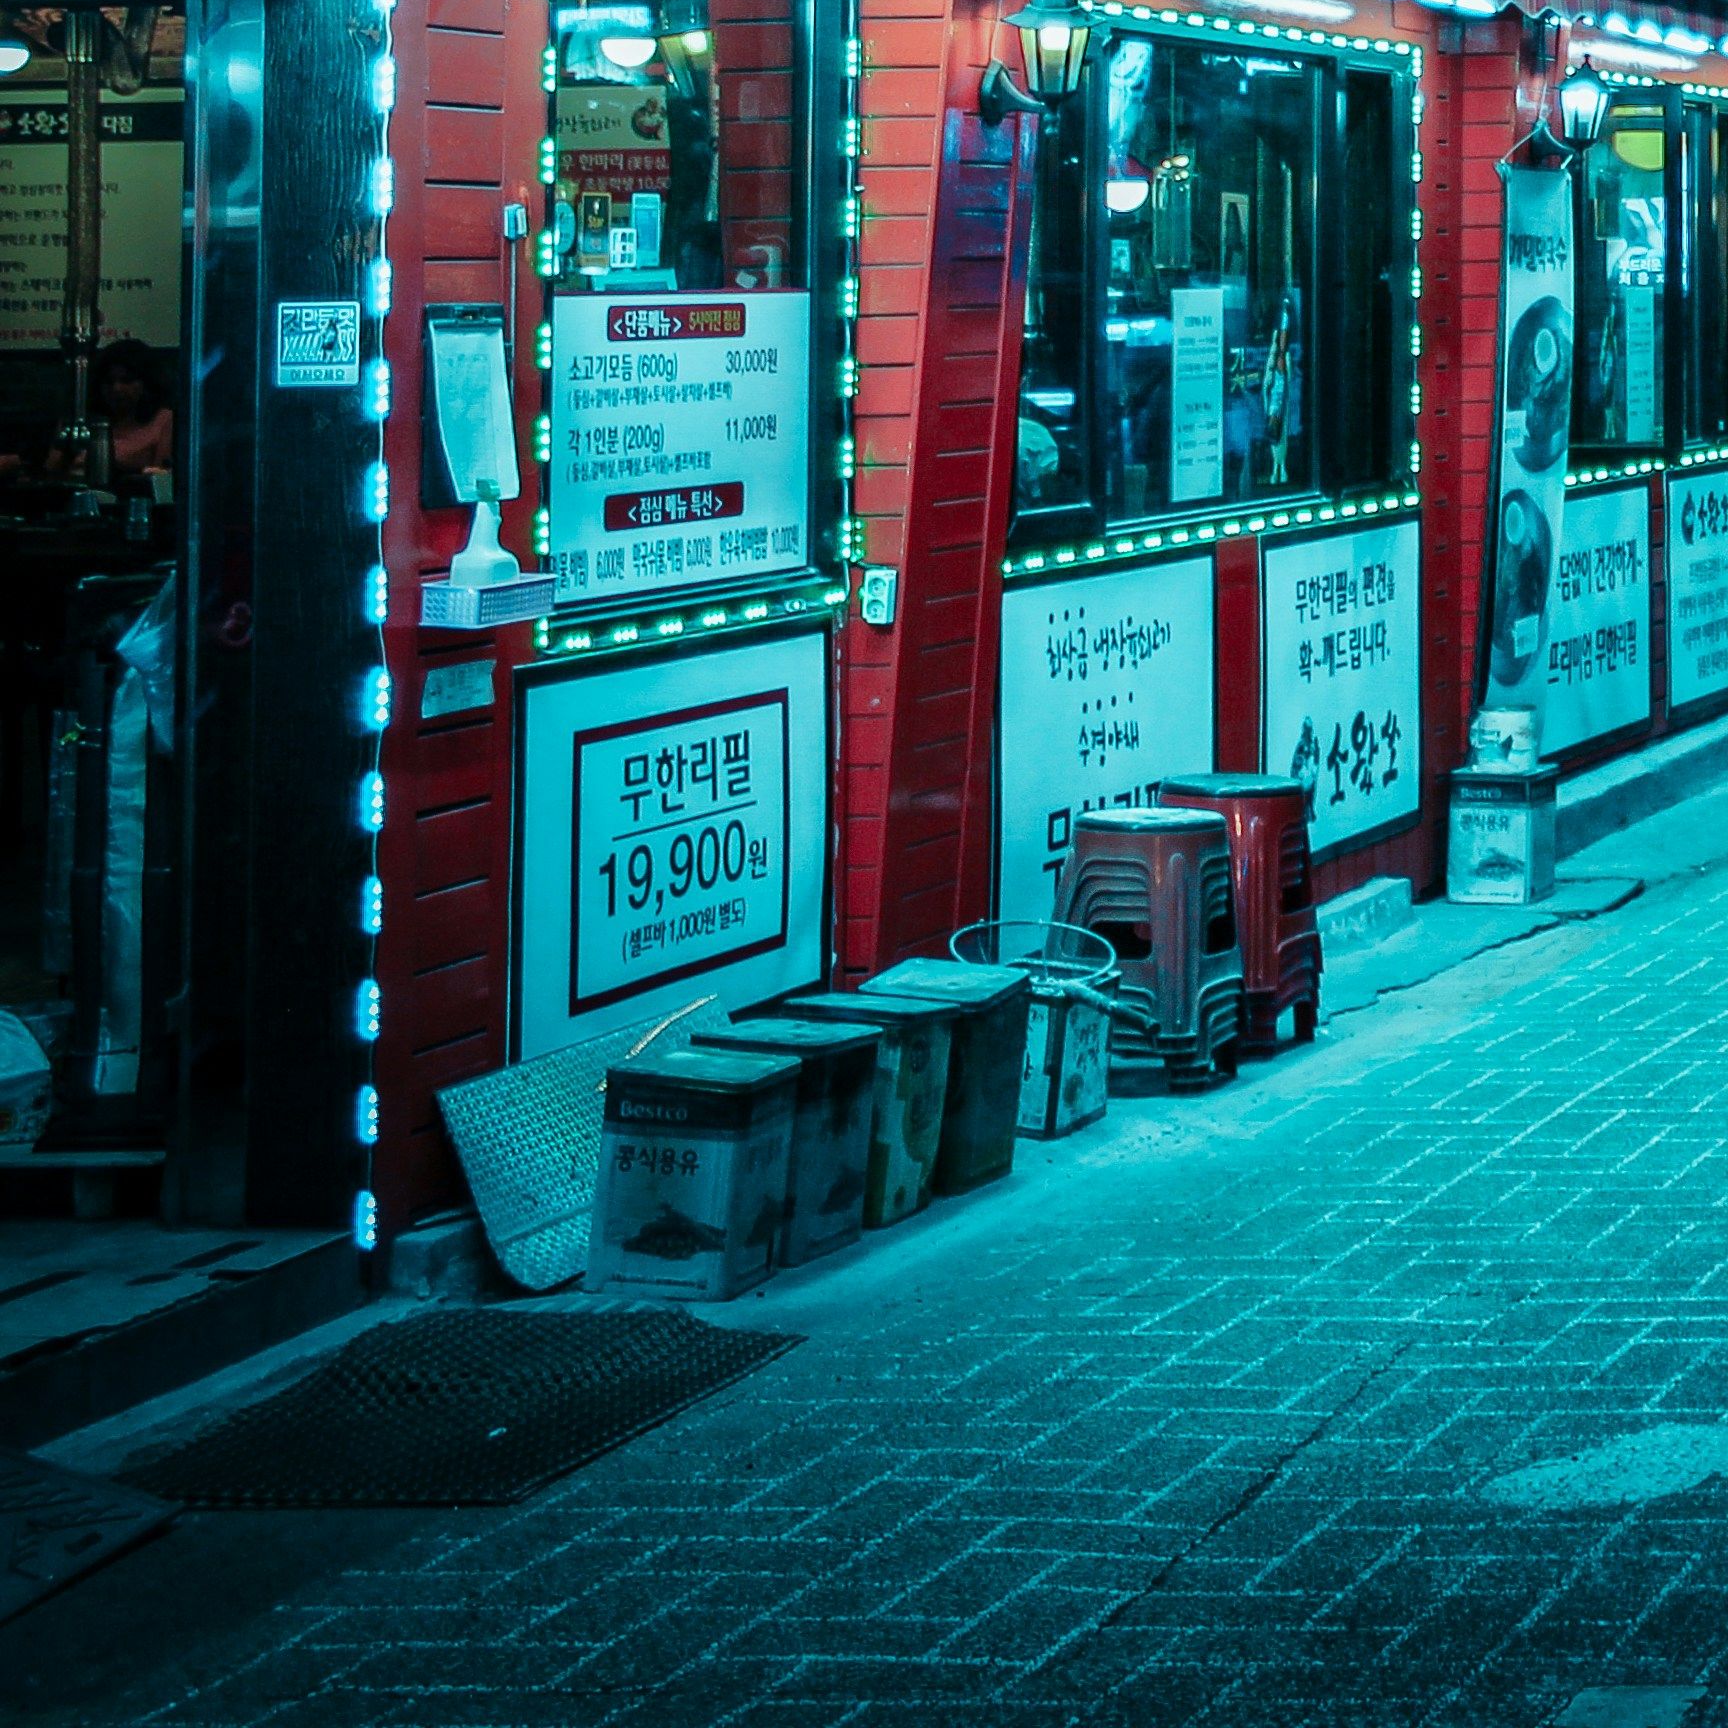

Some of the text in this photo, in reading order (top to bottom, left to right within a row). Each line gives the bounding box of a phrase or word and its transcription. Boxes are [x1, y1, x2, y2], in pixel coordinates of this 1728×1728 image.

[637, 352, 678, 383] (600g)
[725, 348, 778, 376] 30,000원
[585, 426, 619, 453] 1인분
[623, 423, 665, 456] (200g)
[725, 414, 778, 442] 11,000원
[1295, 568, 1358, 624] 무한리필의
[619, 728, 753, 823] 무한리필
[598, 818, 769, 918] 19,900원
[669, 908, 717, 947] 1,000원
[718, 896, 746, 929] 별도)
[619, 1099, 689, 1122] Bestco
